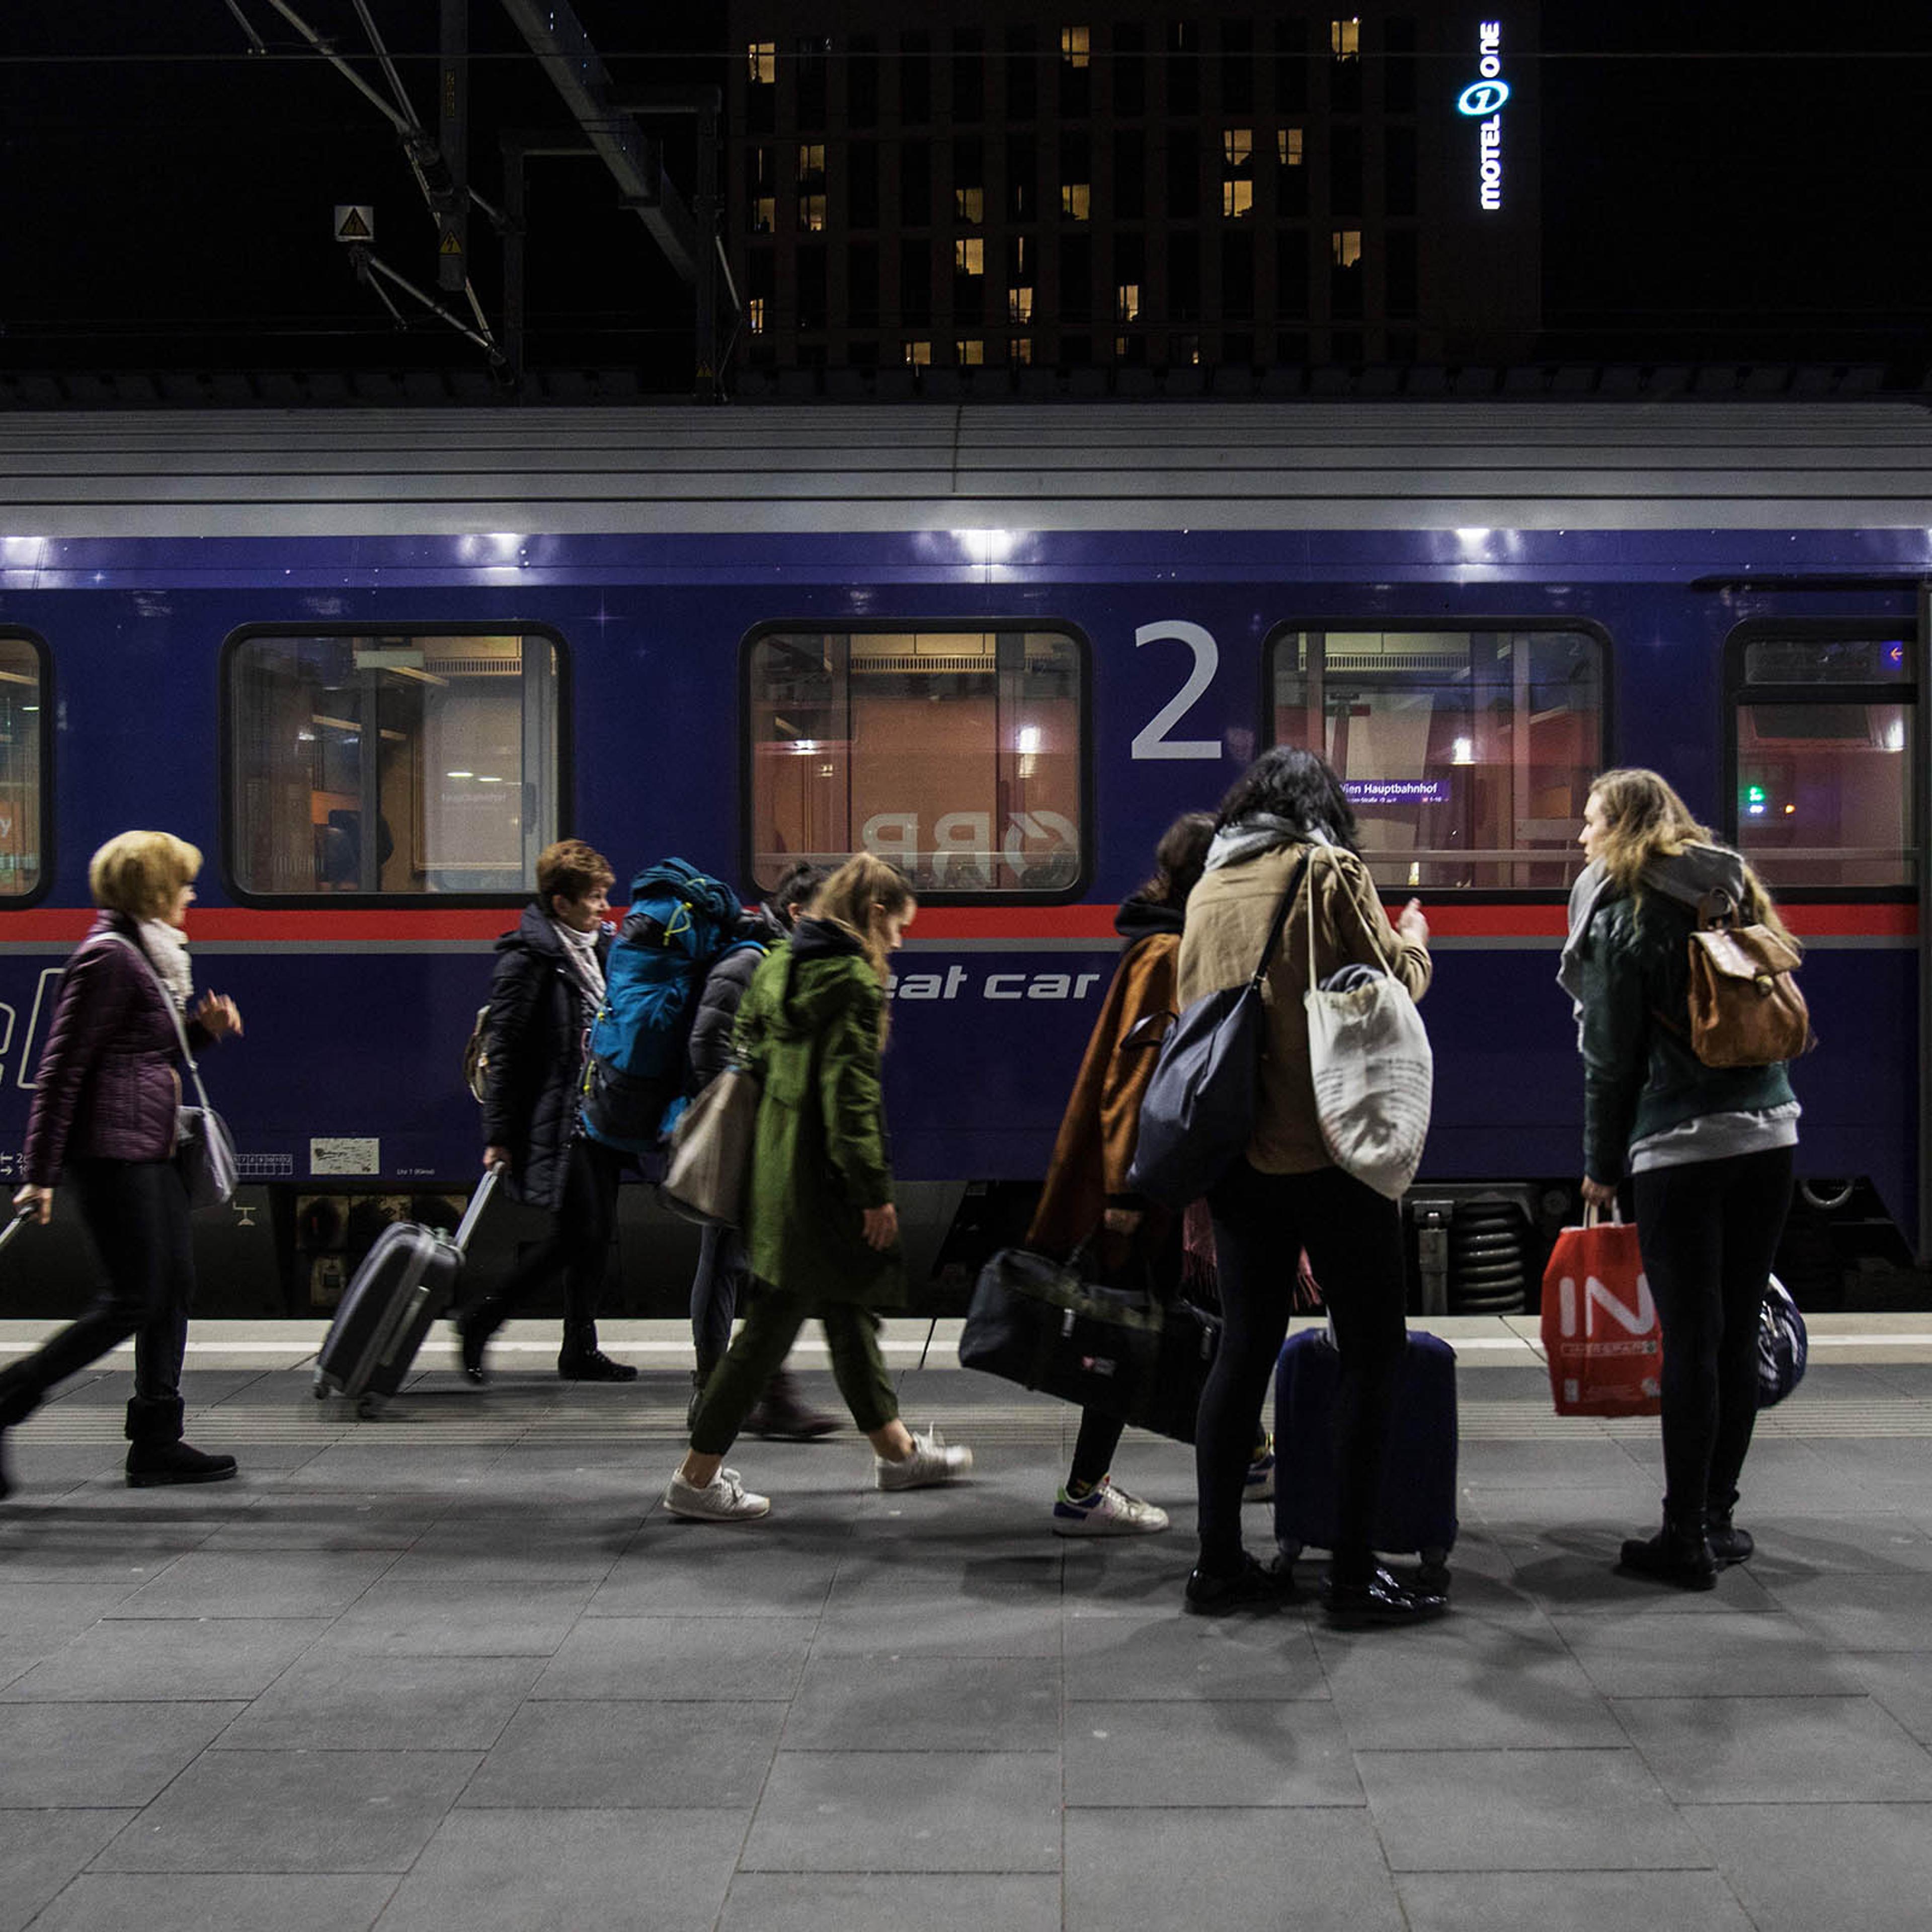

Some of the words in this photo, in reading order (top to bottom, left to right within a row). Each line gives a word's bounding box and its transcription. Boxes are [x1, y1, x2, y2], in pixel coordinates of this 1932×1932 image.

[1480, 22, 1500, 78] ONE
[1480, 114, 1501, 210] MOTEL
[1132, 620, 1222, 759] 2
[1364, 782, 1438, 795] Hauptbahnhof
[887, 965, 968, 999] at
[984, 974, 1101, 999] car
